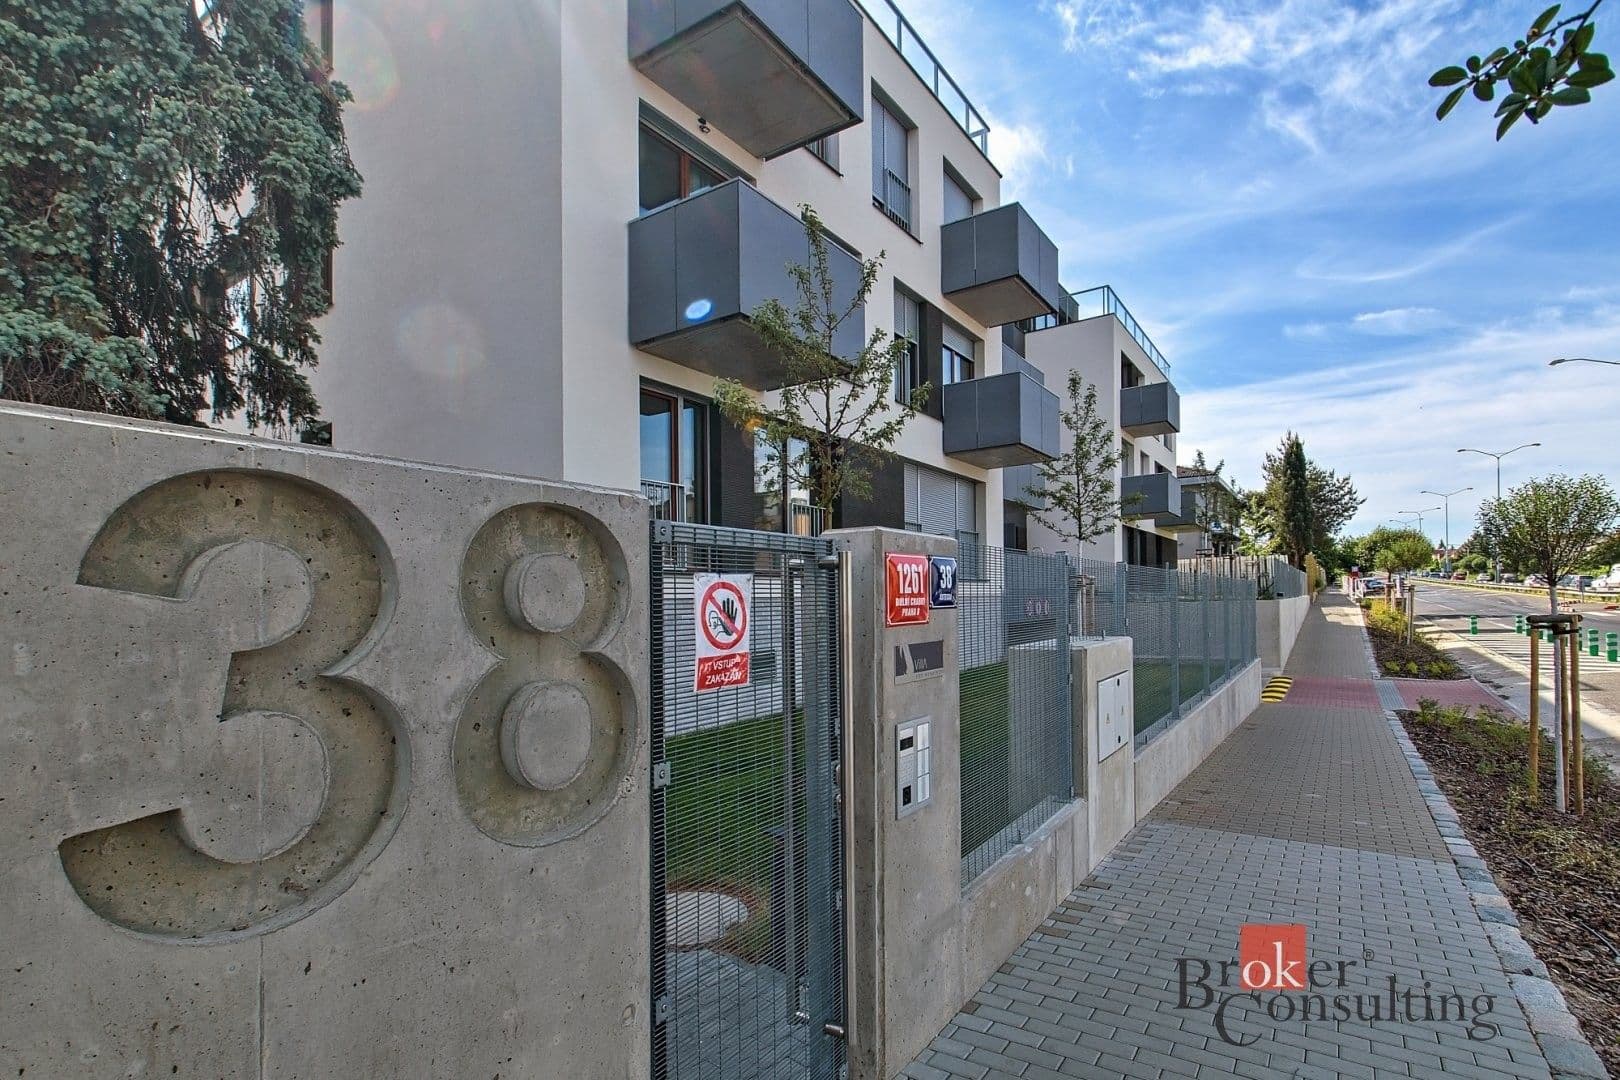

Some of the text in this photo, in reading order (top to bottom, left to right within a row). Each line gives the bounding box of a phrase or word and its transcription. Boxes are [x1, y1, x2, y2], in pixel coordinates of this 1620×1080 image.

[897, 563, 924, 594] 1261
[940, 565, 952, 589] 38
[713, 659, 736, 670] VSTUP
[58, 467, 640, 947] 38
